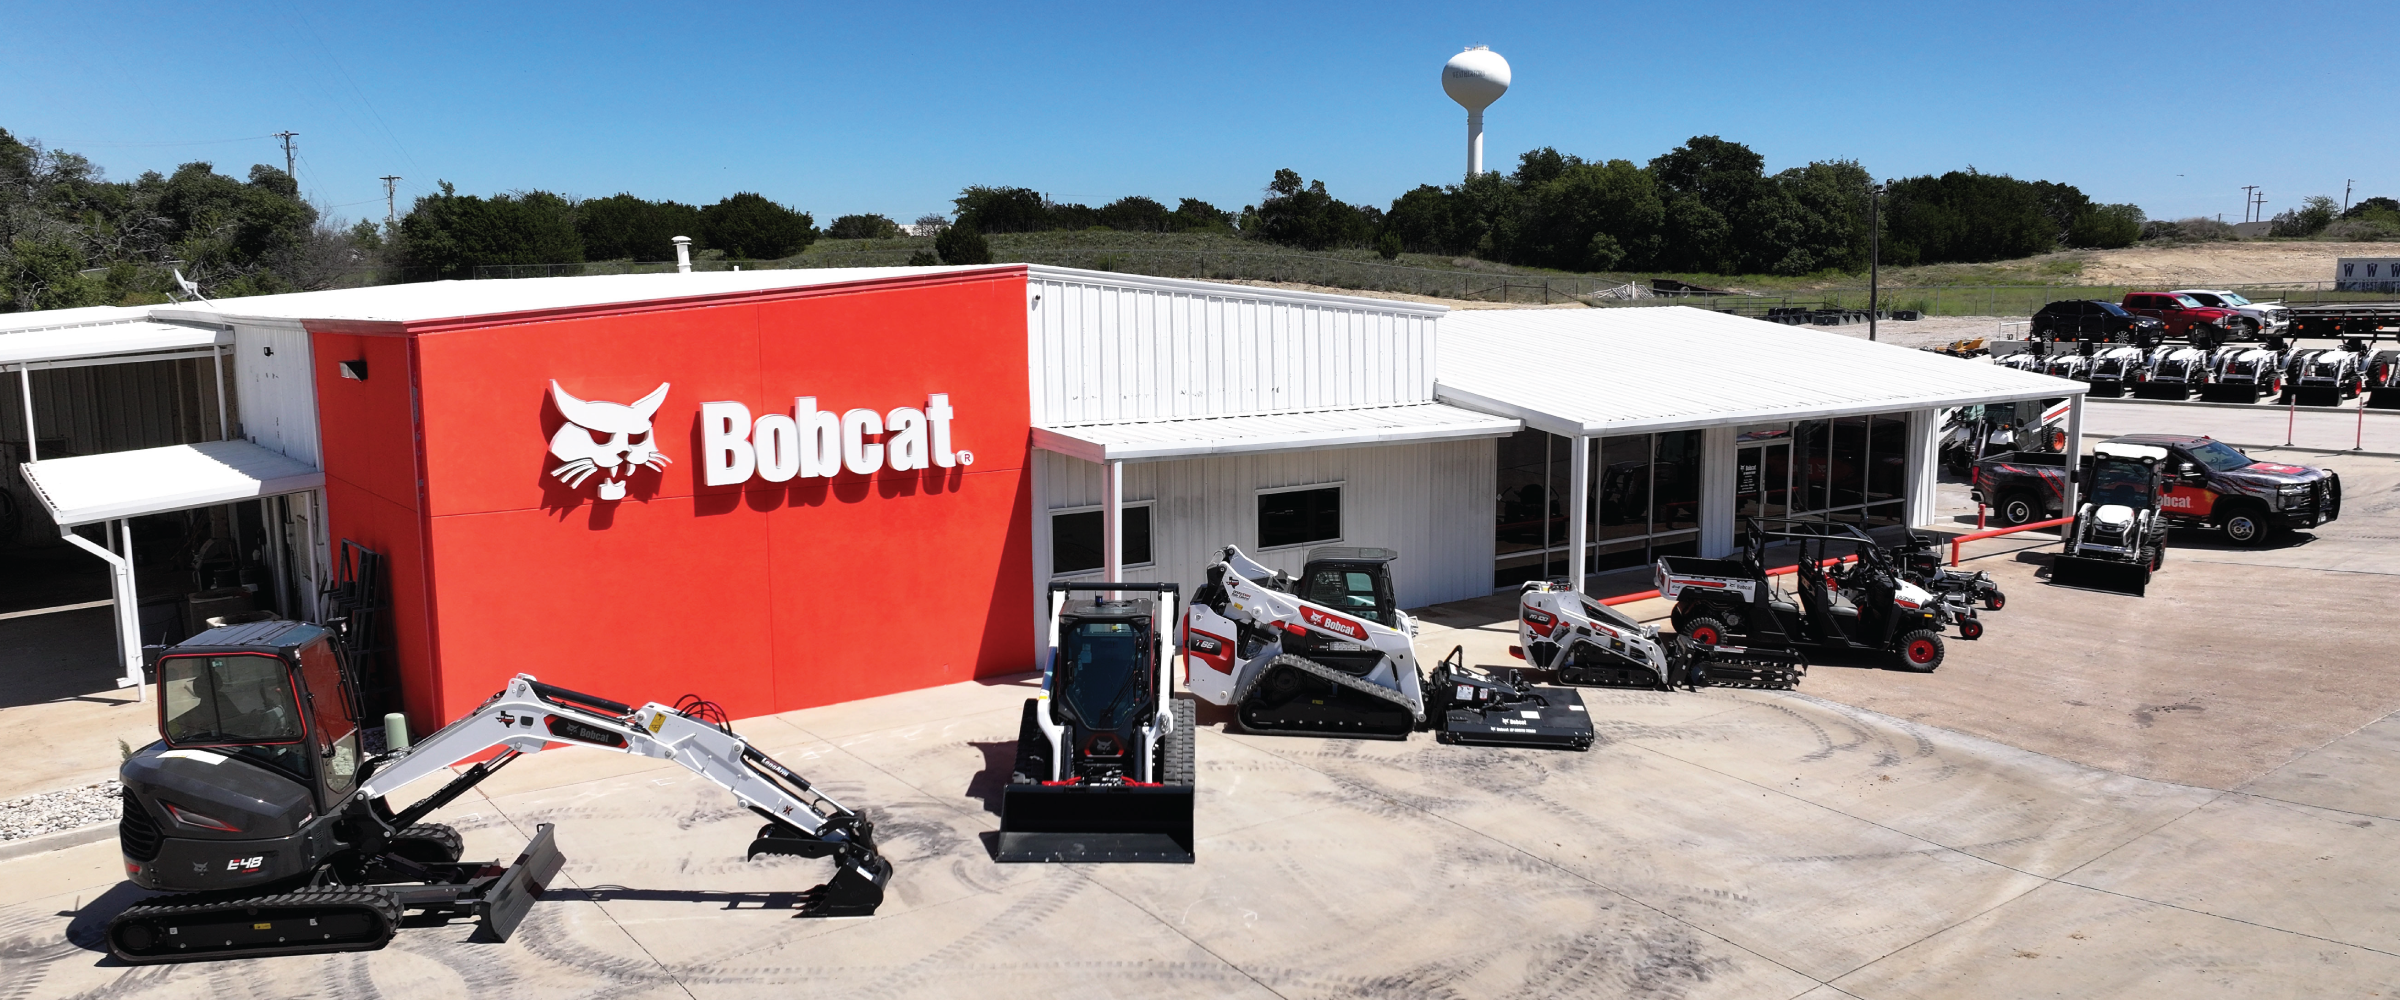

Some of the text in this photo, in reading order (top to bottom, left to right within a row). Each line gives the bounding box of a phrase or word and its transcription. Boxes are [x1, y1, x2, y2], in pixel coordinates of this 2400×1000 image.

[700, 393, 956, 487] Bobcat
[1324, 618, 1355, 635] Bobcat
[1196, 640, 1215, 649] T86
[580, 727, 610, 742] Bobcat
[226, 856, 264, 870] E48
